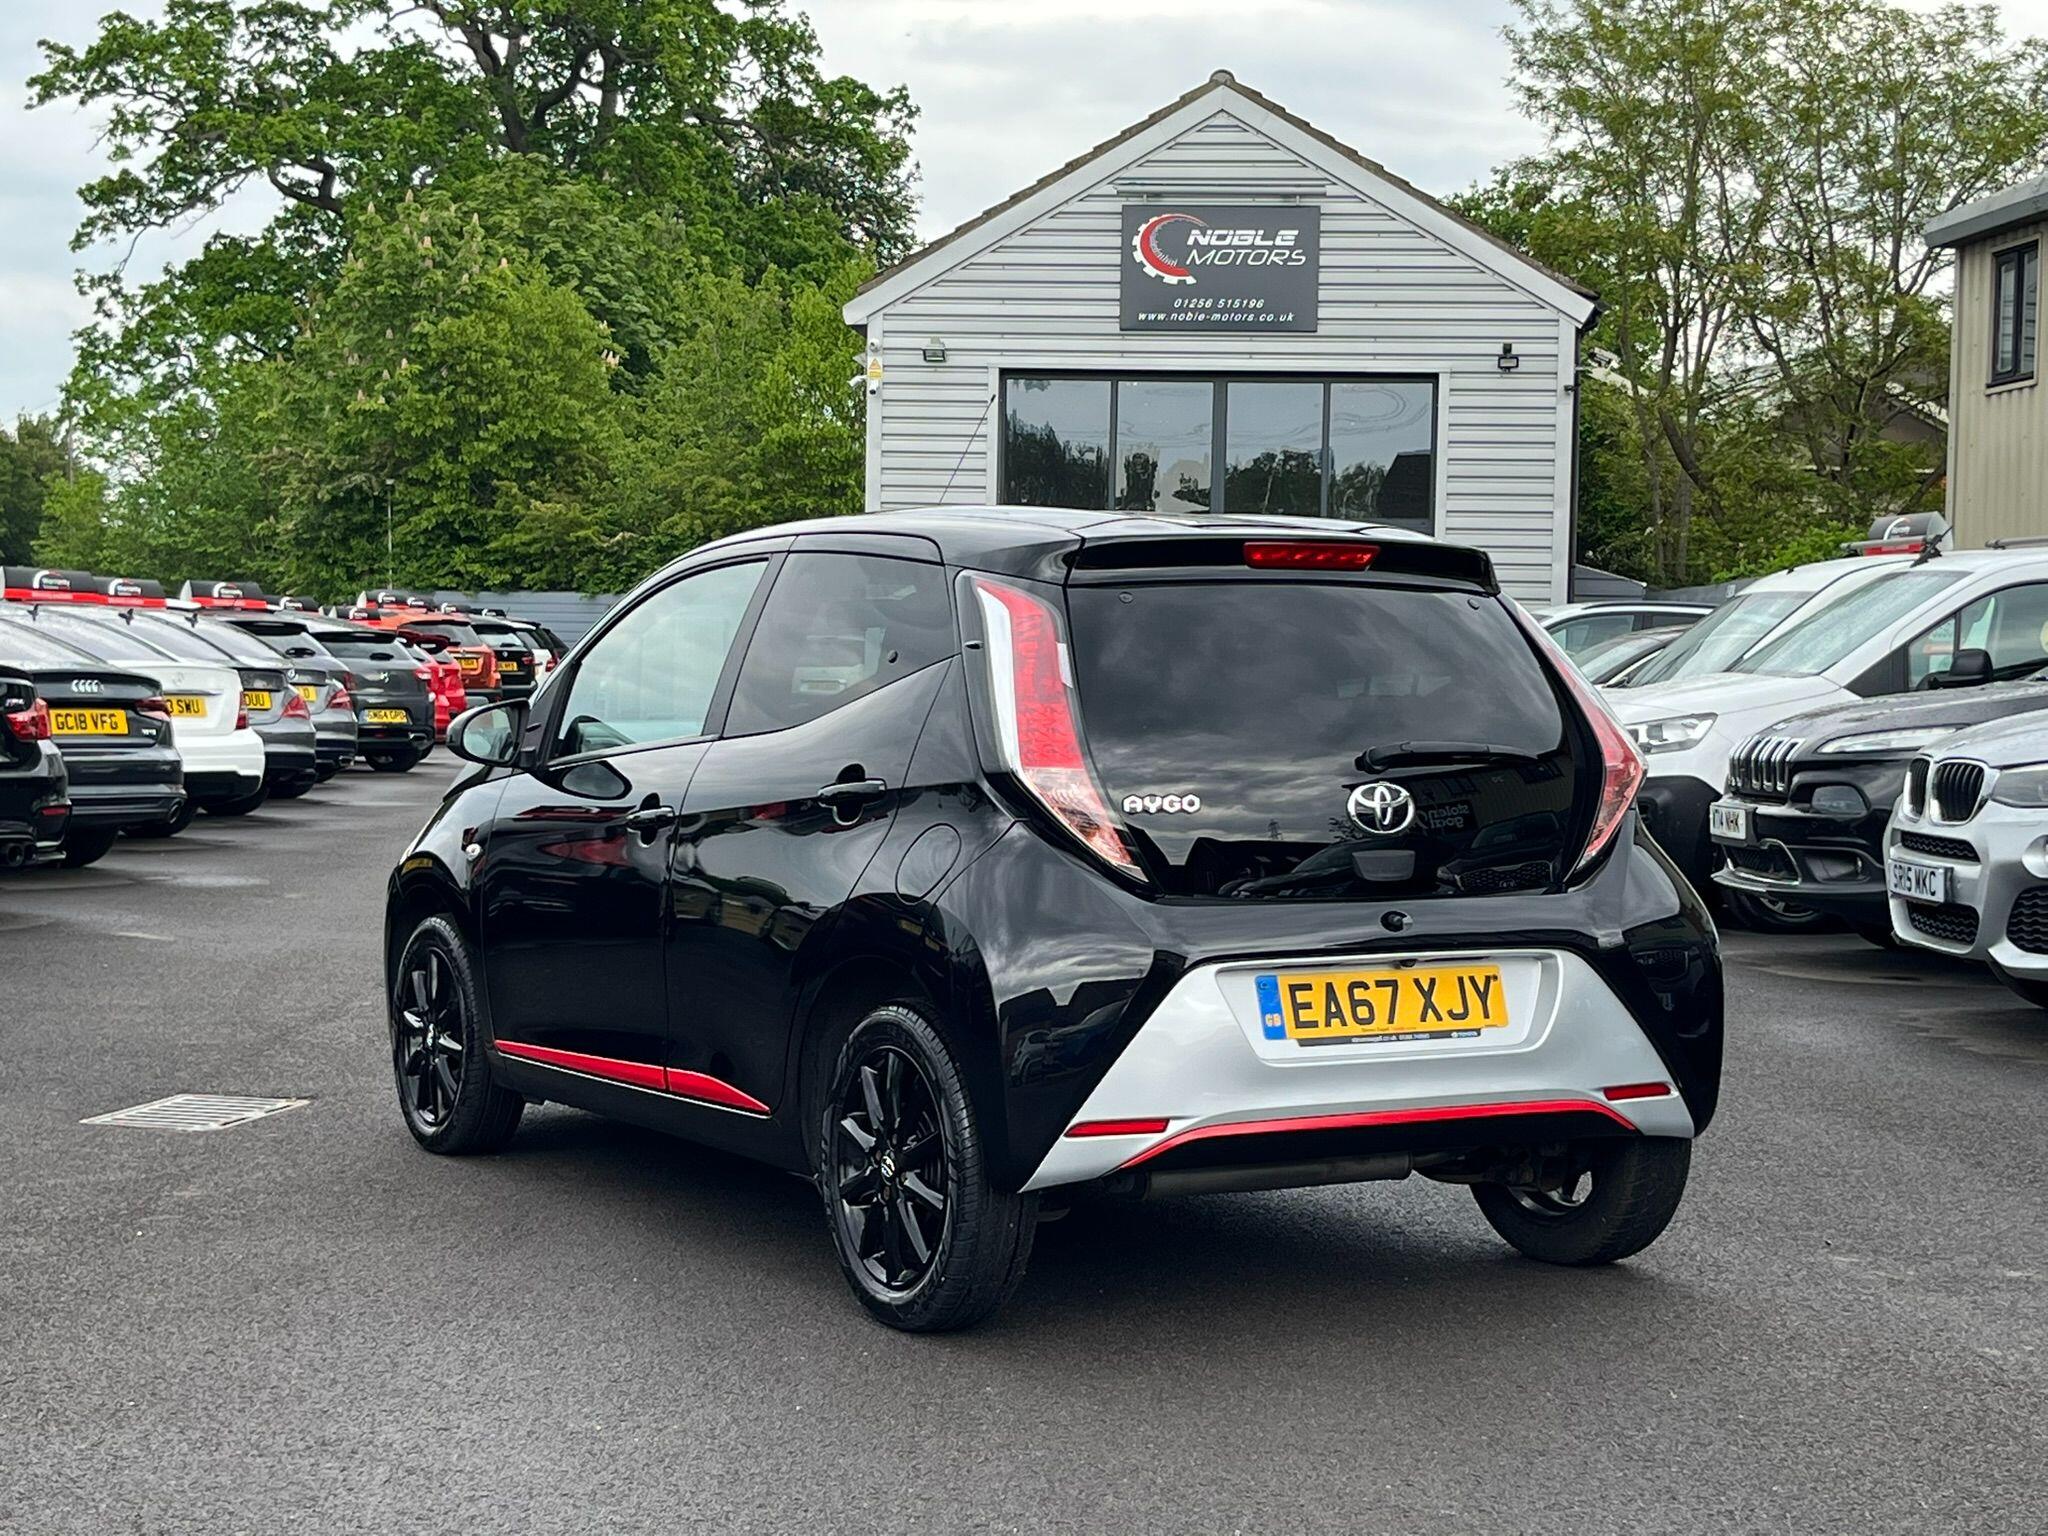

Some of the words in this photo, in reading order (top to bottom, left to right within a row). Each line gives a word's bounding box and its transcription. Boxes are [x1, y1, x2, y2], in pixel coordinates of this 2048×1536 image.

[1187, 229, 1299, 246] NOBLE
[1186, 249, 1307, 266] MOTORS
[1174, 298, 1211, 309] 01256
[1217, 298, 1265, 309] 515196
[1138, 311, 1295, 322] www.noble-motors.co.uk
[55, 713, 87, 730] GC18
[1123, 794, 1200, 813] AYGO
[1288, 979, 1399, 1030] EA67
[1413, 974, 1492, 1023] XJY
